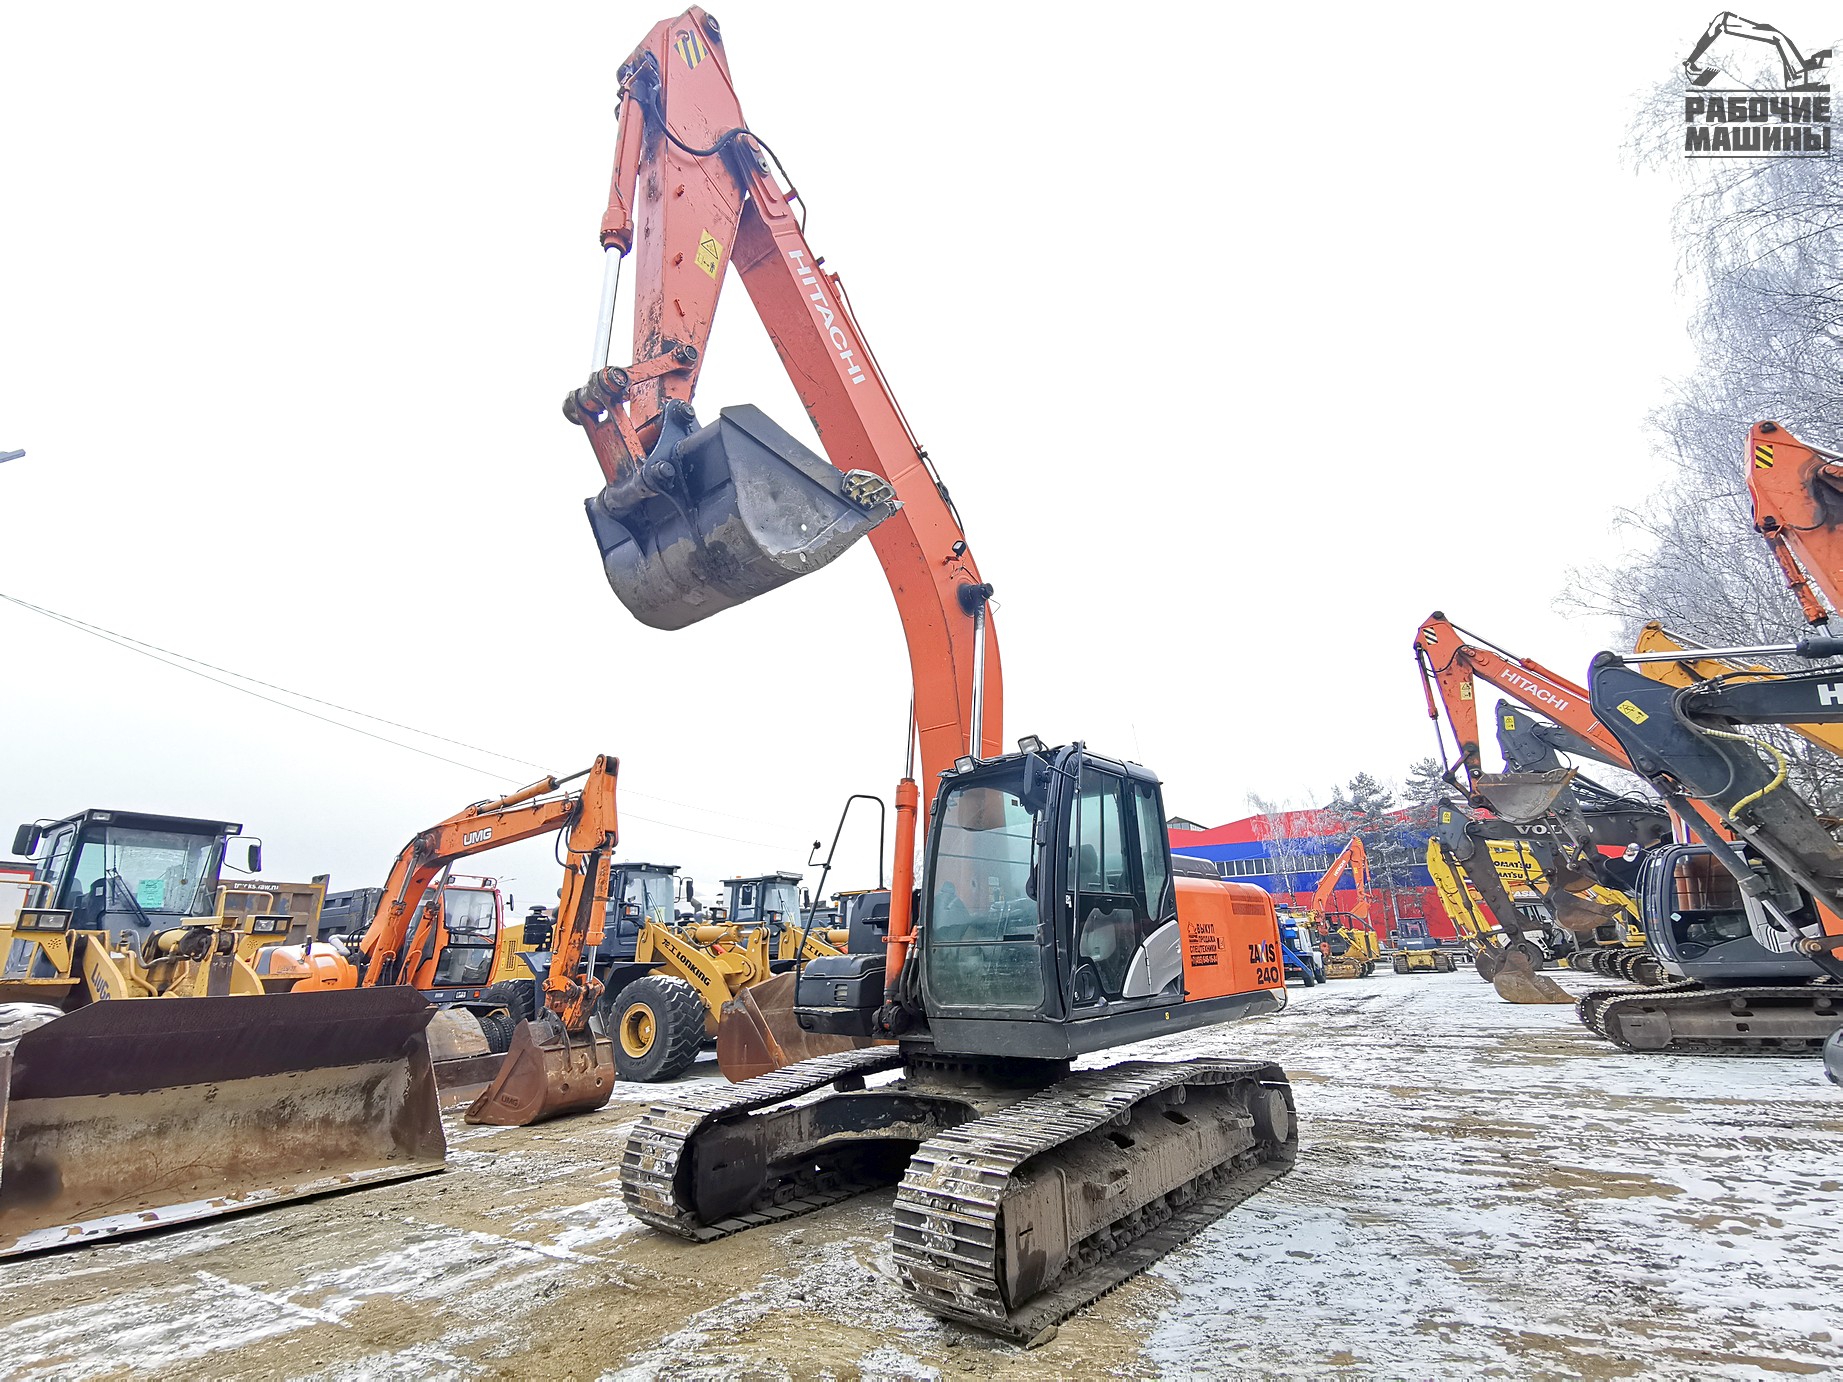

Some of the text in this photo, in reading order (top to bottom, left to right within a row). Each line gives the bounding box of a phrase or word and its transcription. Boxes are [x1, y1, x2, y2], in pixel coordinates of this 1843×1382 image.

[788, 249, 866, 385] HITACHI
[1500, 668, 1569, 711] HITACHI
[463, 827, 493, 847] UMG
[1248, 939, 1276, 964] ZAXIS
[1256, 966, 1279, 985] 240
